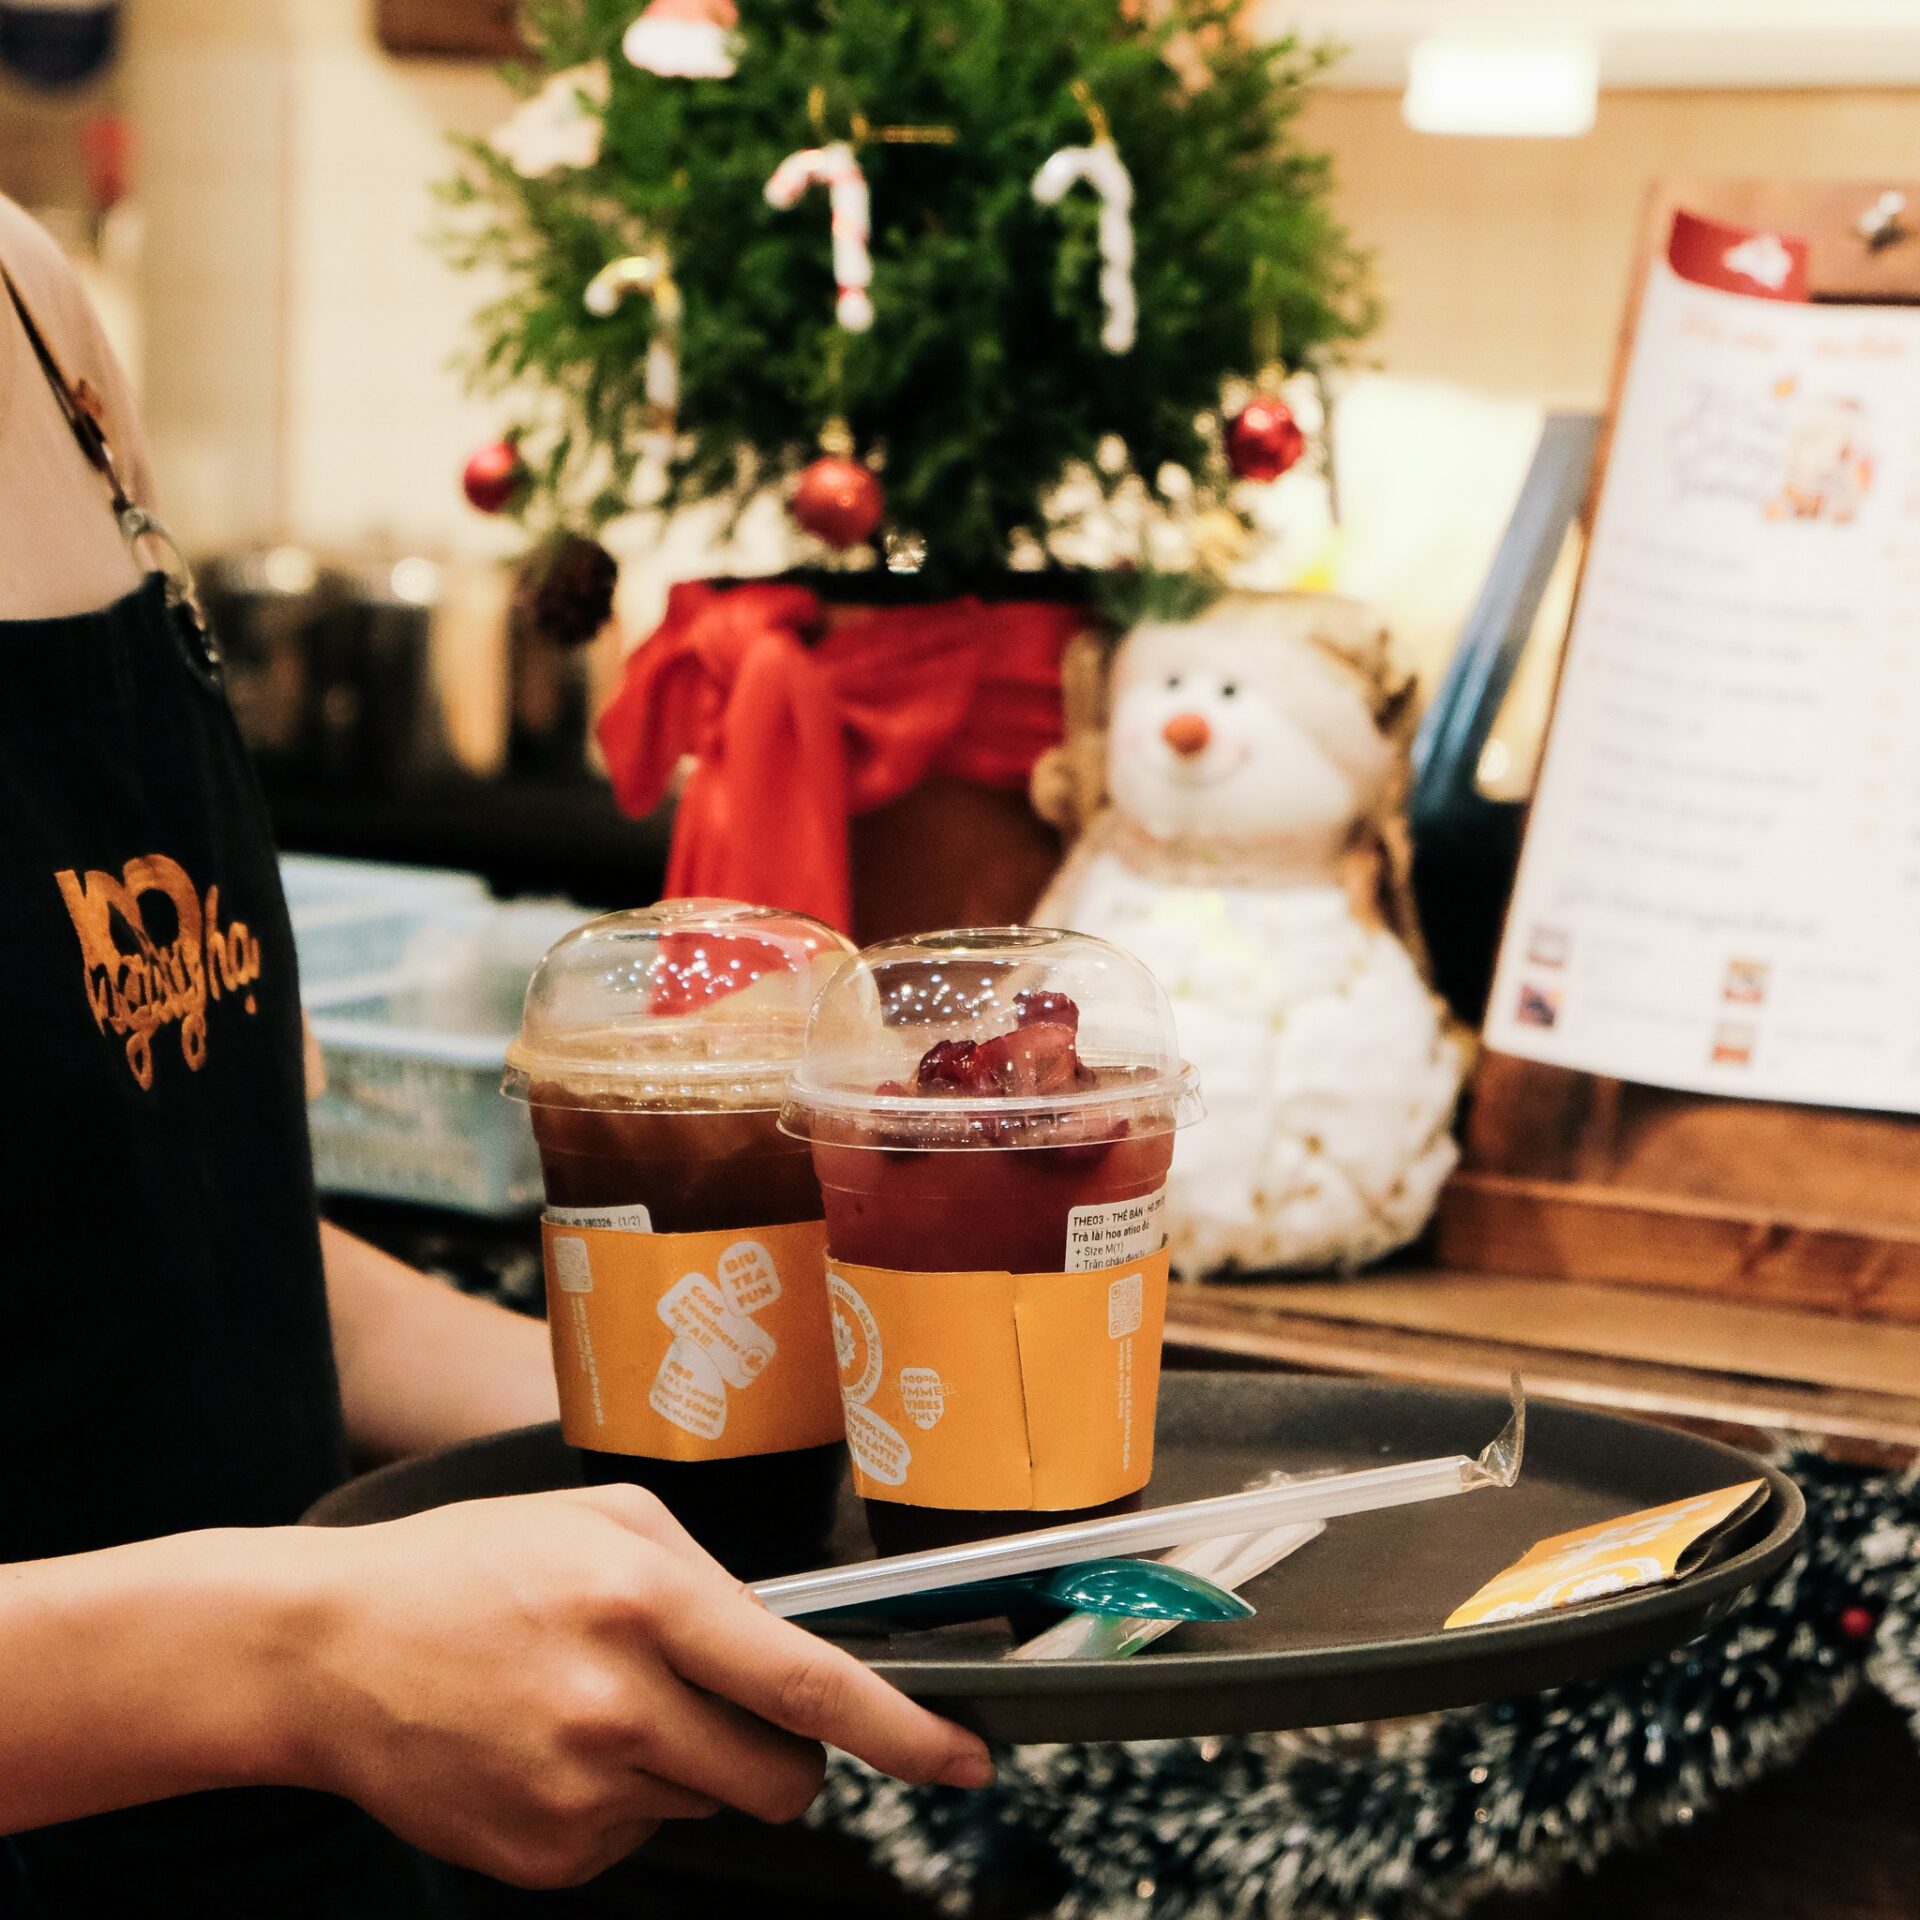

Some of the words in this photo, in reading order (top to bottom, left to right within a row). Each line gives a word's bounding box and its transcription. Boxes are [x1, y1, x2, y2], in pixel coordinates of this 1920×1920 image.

[618, 1215, 641, 1227] (1/2)
[1073, 1215, 1104, 1227] THE03
[1072, 1232, 1089, 1242] Trà
[1105, 1229, 1121, 1240] hoa
[1123, 1224, 1141, 1237] atiso
[1084, 1246, 1104, 1257] Size
[1105, 1241, 1124, 1254] M(1)
[730, 1267, 769, 1290] TEA
[903, 1374, 938, 1384] 100%
[904, 1399, 940, 1410] VIBES
